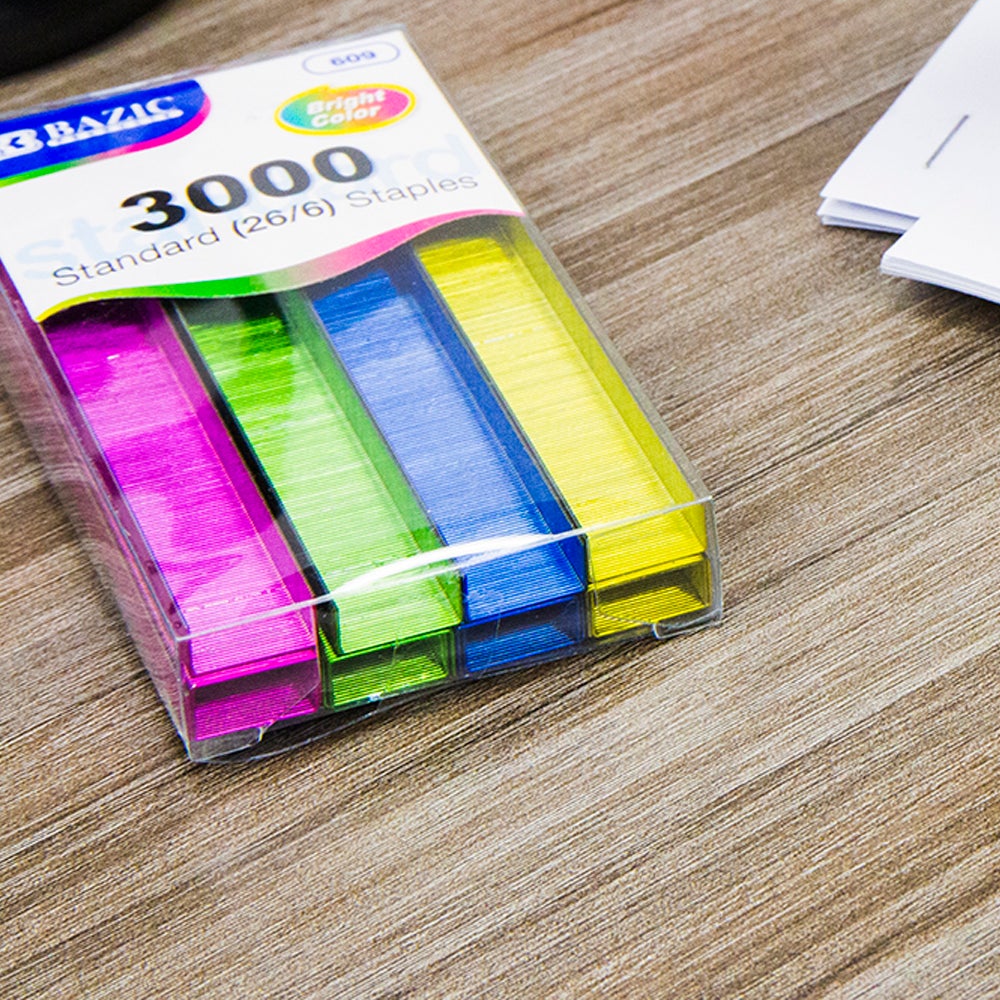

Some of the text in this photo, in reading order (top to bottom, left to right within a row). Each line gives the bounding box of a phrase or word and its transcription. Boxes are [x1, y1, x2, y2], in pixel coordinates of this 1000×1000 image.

[330, 50, 377, 66] 609
[43, 96, 184, 147] BAZIC
[306, 90, 386, 116] Bright
[310, 105, 382, 128] Color
[120, 146, 374, 232] 3000
[52, 170, 479, 288] Standard (26/6) Staples
